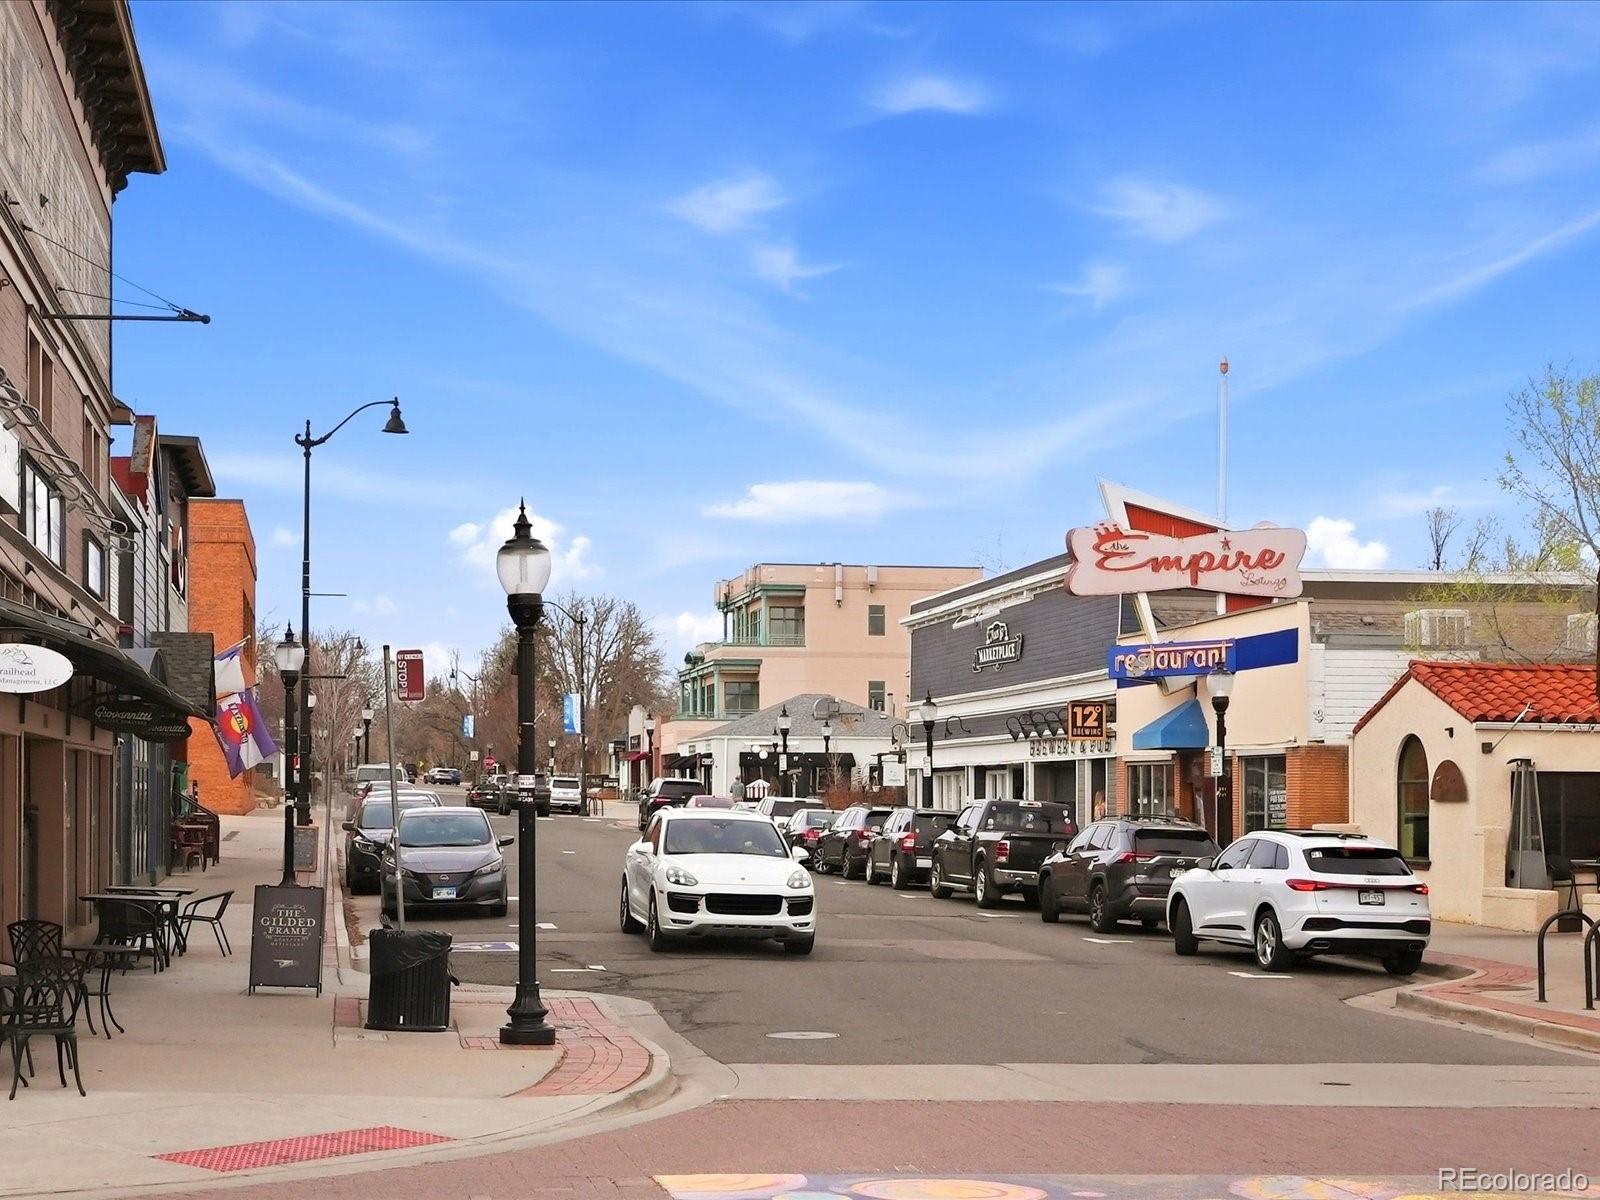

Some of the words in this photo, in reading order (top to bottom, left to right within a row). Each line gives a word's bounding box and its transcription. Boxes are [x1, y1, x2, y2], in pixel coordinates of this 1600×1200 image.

[1106, 542, 1129, 551] the
[1092, 531, 1285, 586] Empire
[978, 643, 1016, 663] MARKETPLACE
[1114, 641, 1234, 673] restaurant
[0, 667, 36, 677] railhead
[398, 660, 408, 688] STOP
[1072, 727, 1102, 736] BREWING
[1029, 739, 1076, 757] BREWERY
[1089, 739, 1112, 753] PUB
[277, 909, 301, 918] THE
[260, 916, 316, 927] GILDED
[268, 926, 308, 935] FRAME
